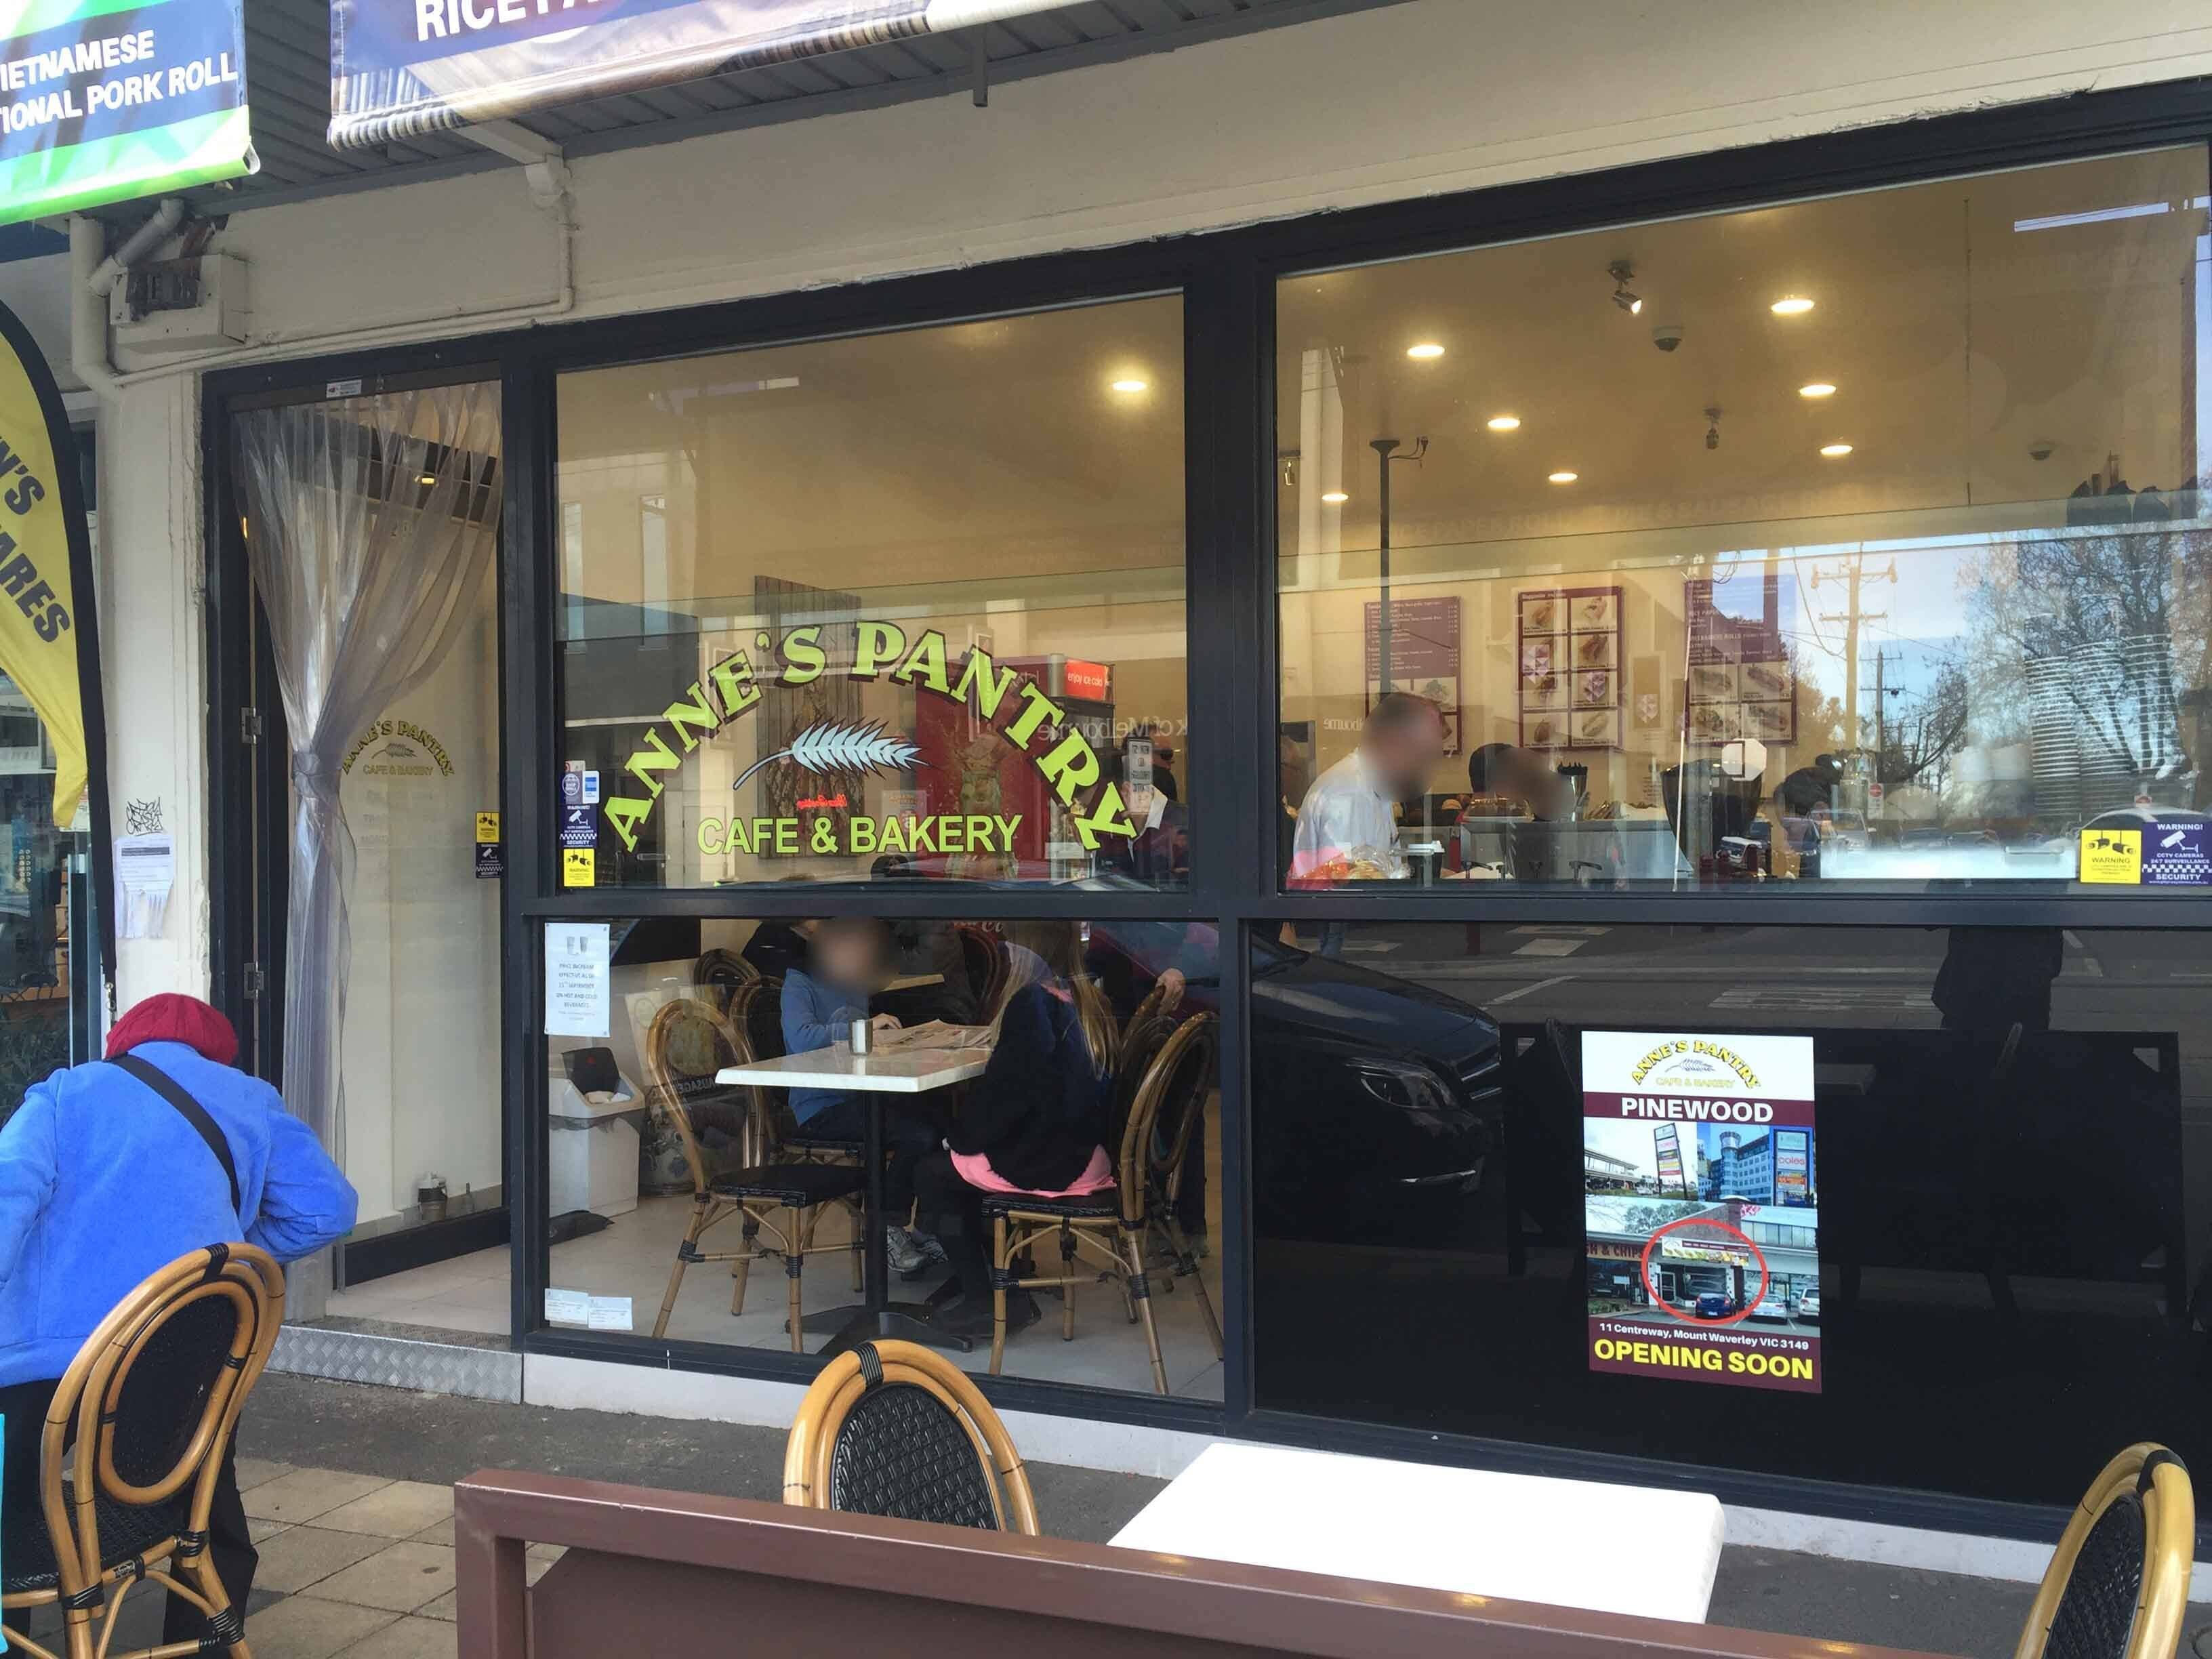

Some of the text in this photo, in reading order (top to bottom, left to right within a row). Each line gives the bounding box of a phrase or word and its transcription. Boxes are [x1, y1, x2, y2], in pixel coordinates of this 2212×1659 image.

[87, 70, 163, 115] PORK
[168, 52, 239, 97] ROLL
[1067, 673, 1082, 682] enjoy
[397, 720, 455, 777] PANTRY
[604, 619, 1139, 853] ANNE'S PANTRY
[697, 815, 1023, 855] CAFE & BAKERY
[1631, 1040, 1761, 1089] ANNE'S PANTRY
[1621, 1097, 1774, 1122] PINEWOOD
[1599, 1323, 1809, 1351] 11 Centreway, Mount Waverley VIC 3149
[1594, 1338, 1814, 1380] OPENING SOON
